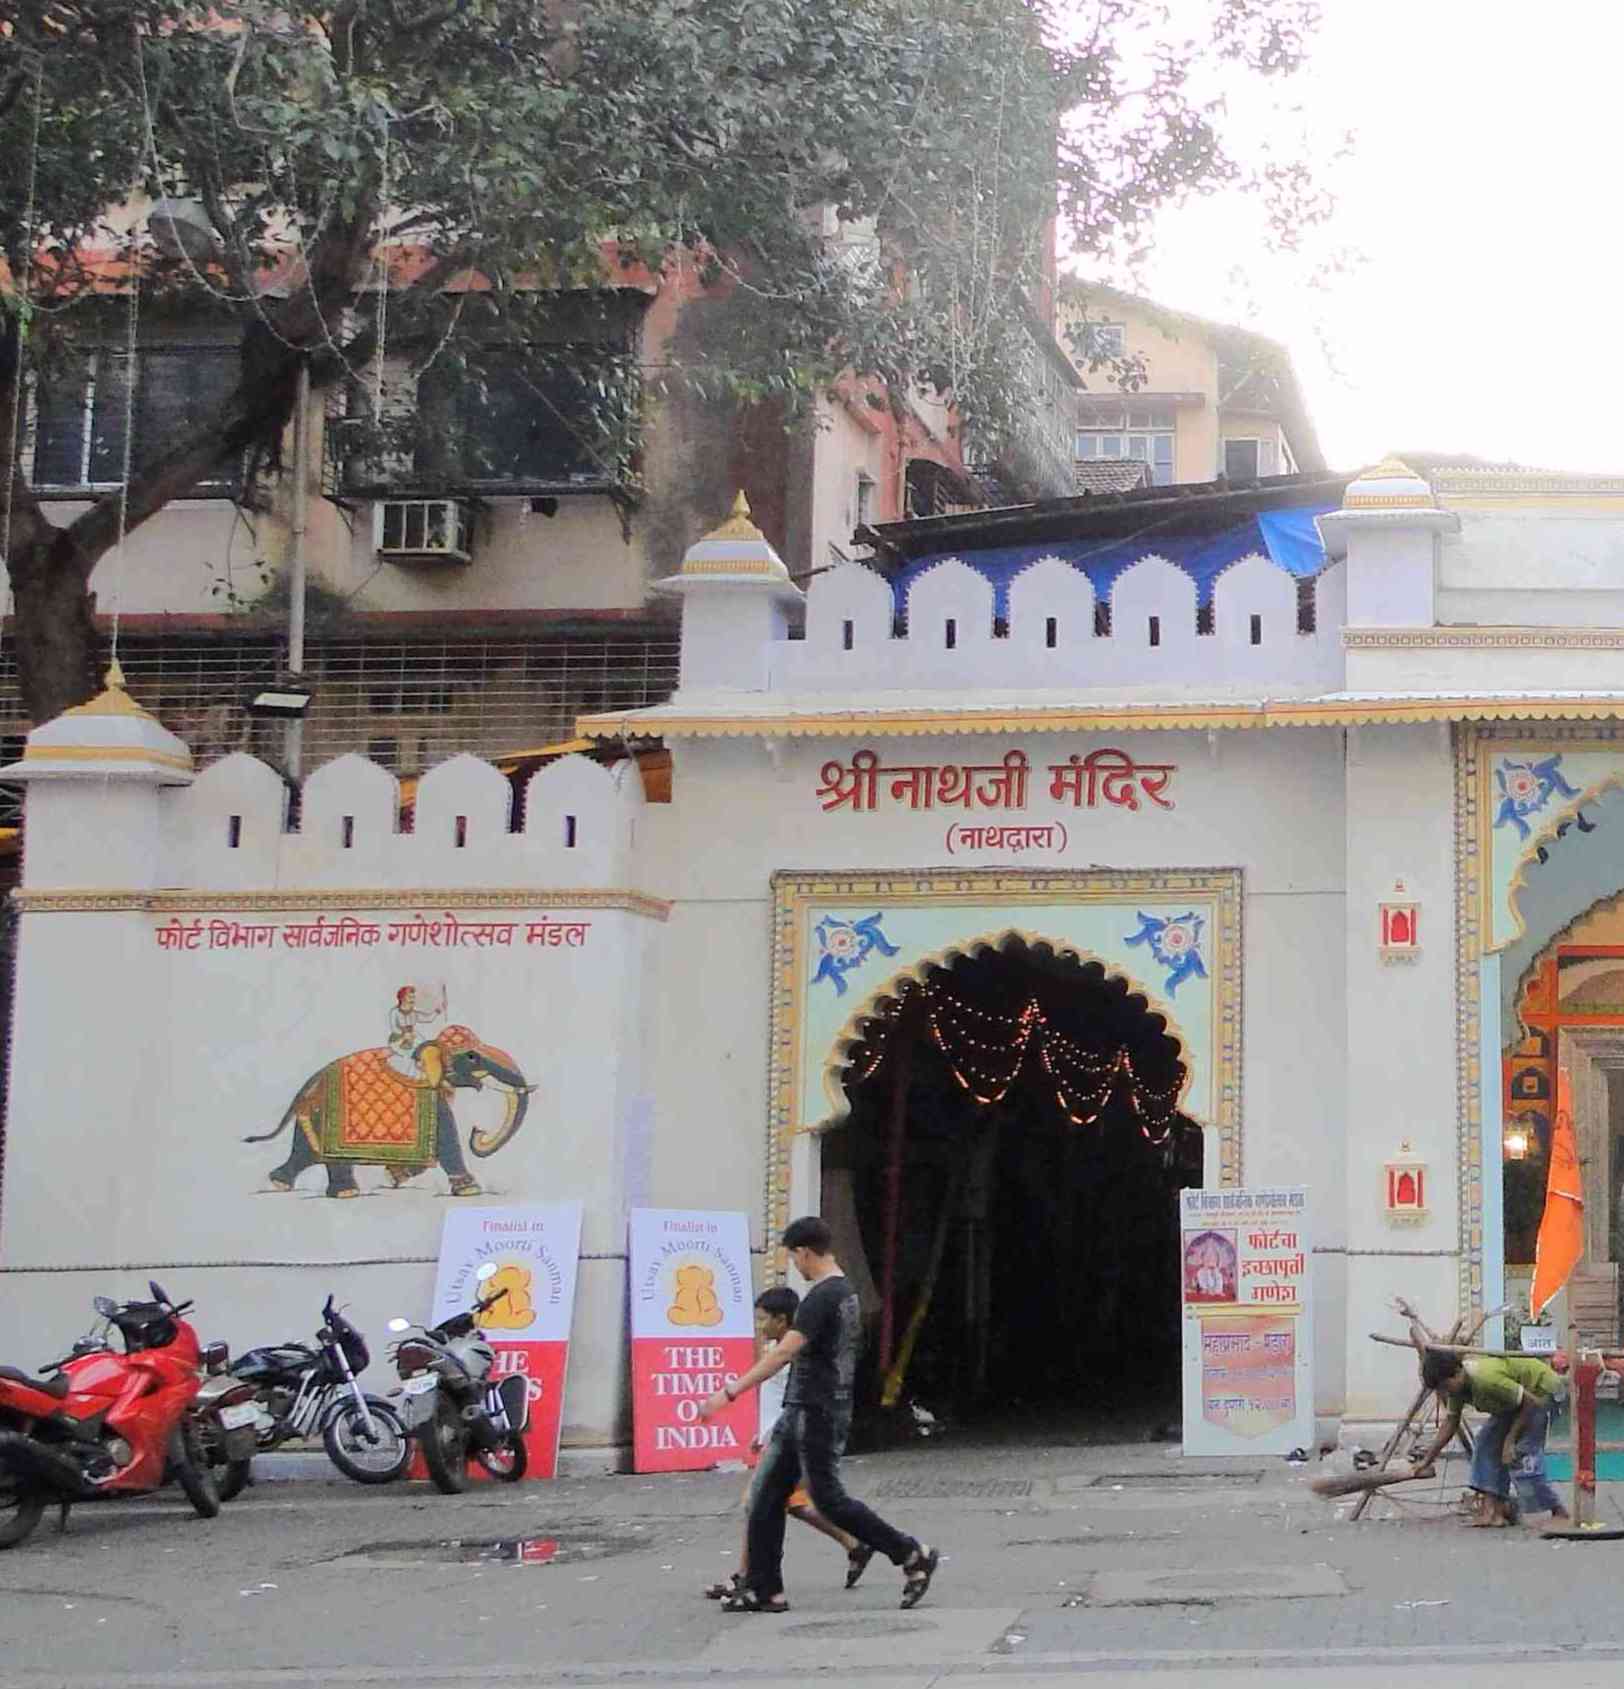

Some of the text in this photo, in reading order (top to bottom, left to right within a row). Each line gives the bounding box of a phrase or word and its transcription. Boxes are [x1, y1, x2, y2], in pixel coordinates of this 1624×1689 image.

[816, 748, 1177, 812] श्रीनाथजी मंदिर
[945, 821, 1068, 854] (नाथद्वारा)
[155, 912, 592, 951] फोर्ट विभाग सार्वजनिक गणेशोत्सव मंडल
[482, 1220, 545, 1233] Finalist in
[664, 1220, 719, 1233] Finalist in
[494, 1350, 529, 1373] HE
[664, 1346, 725, 1368] THE
[656, 1425, 740, 1450] INDIA
